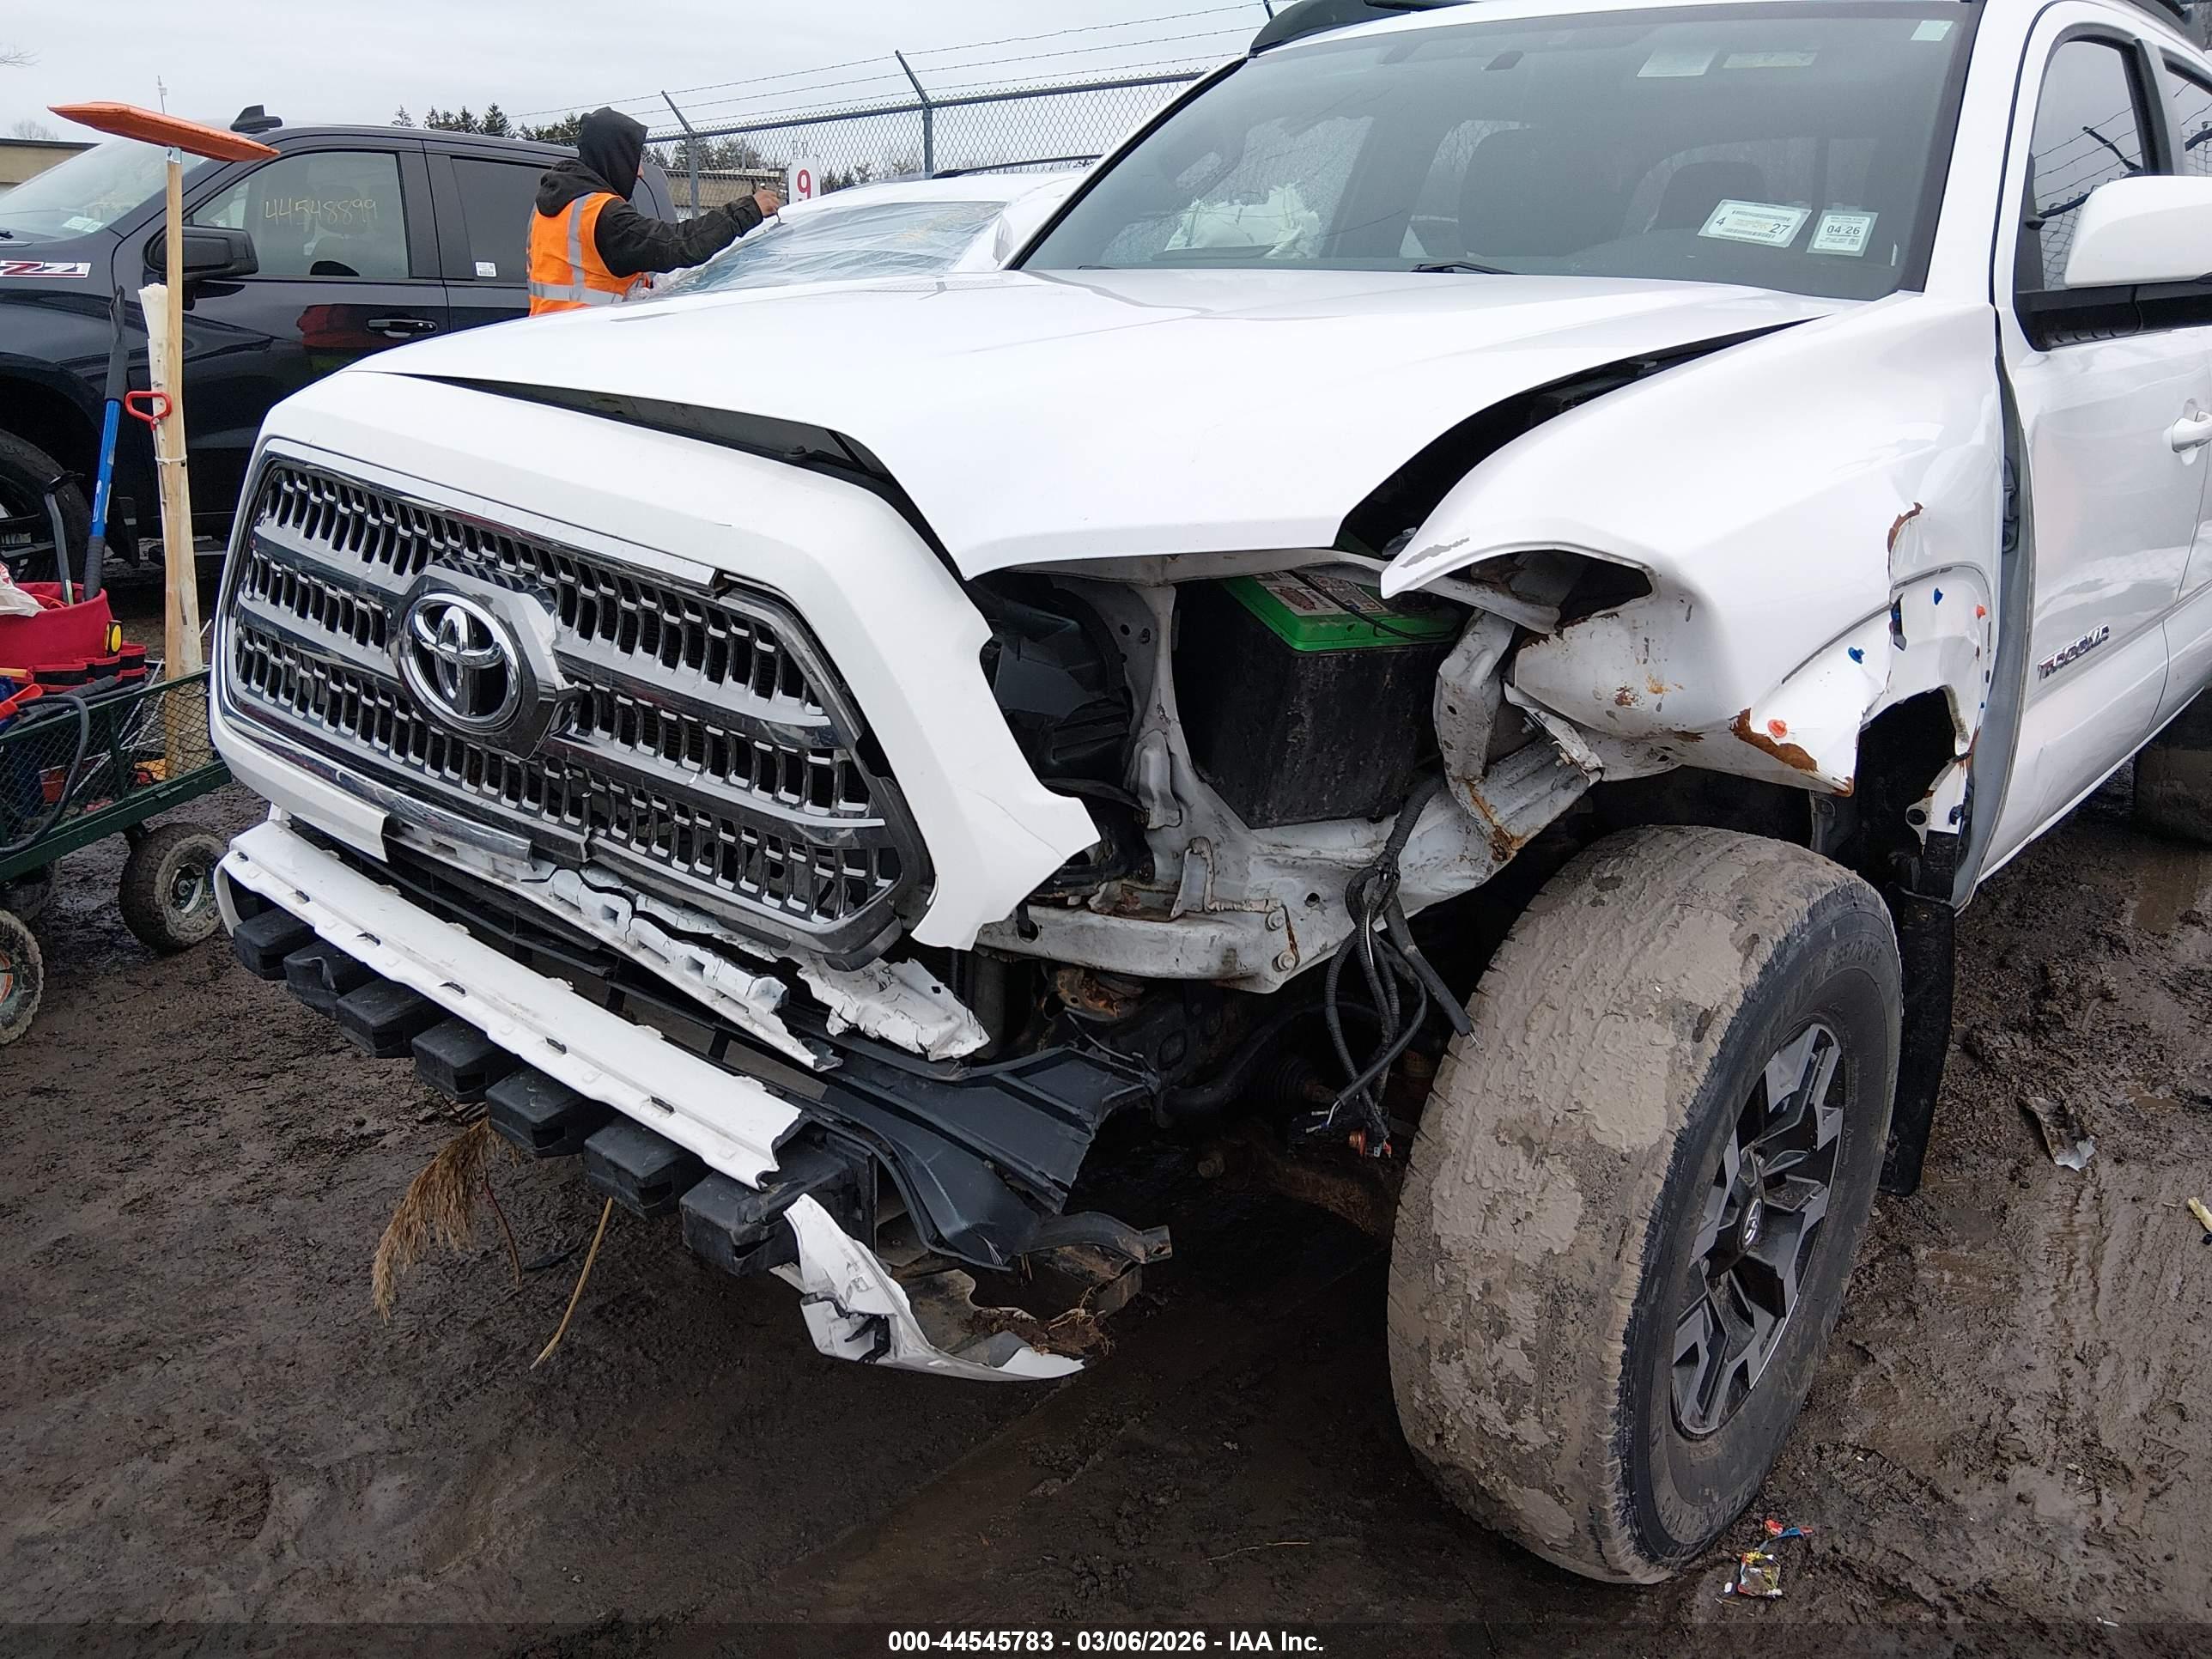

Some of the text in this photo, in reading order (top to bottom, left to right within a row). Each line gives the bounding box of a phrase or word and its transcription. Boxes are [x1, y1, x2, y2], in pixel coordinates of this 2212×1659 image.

[797, 168, 811, 199] 9
[265, 198, 379, 227] 44548899
[1716, 216, 1726, 227] 4
[1769, 222, 1791, 234] 27
[0, 260, 91, 278] Z71
